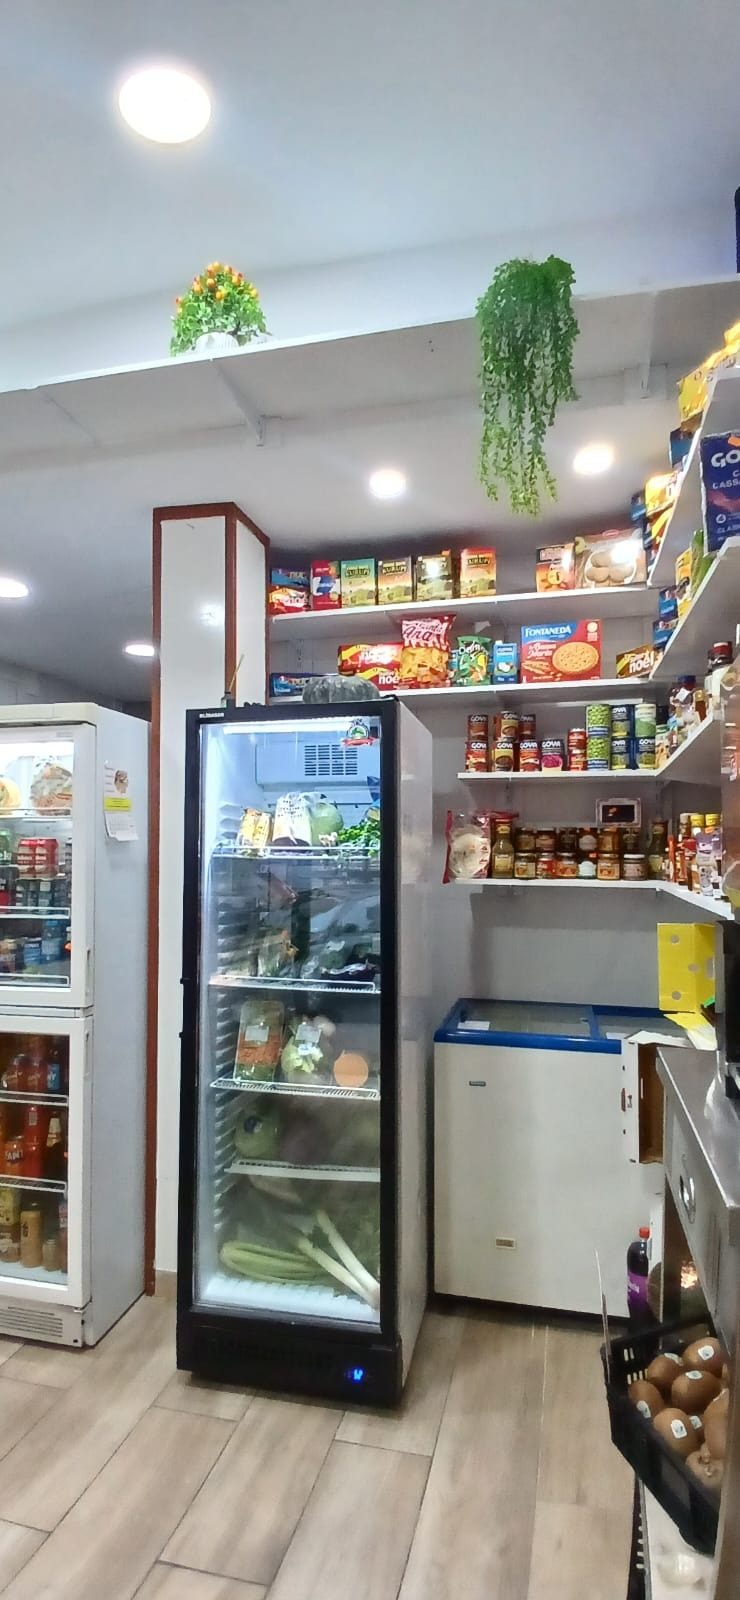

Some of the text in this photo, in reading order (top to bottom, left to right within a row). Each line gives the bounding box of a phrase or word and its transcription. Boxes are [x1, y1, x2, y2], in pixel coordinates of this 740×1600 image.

[712, 477, 740, 489] CASS
[525, 624, 572, 637] FONTANEDA
[378, 673, 400, 685] noe
[519, 741, 538, 749] GOYA
[541, 740, 561, 749] GOYA
